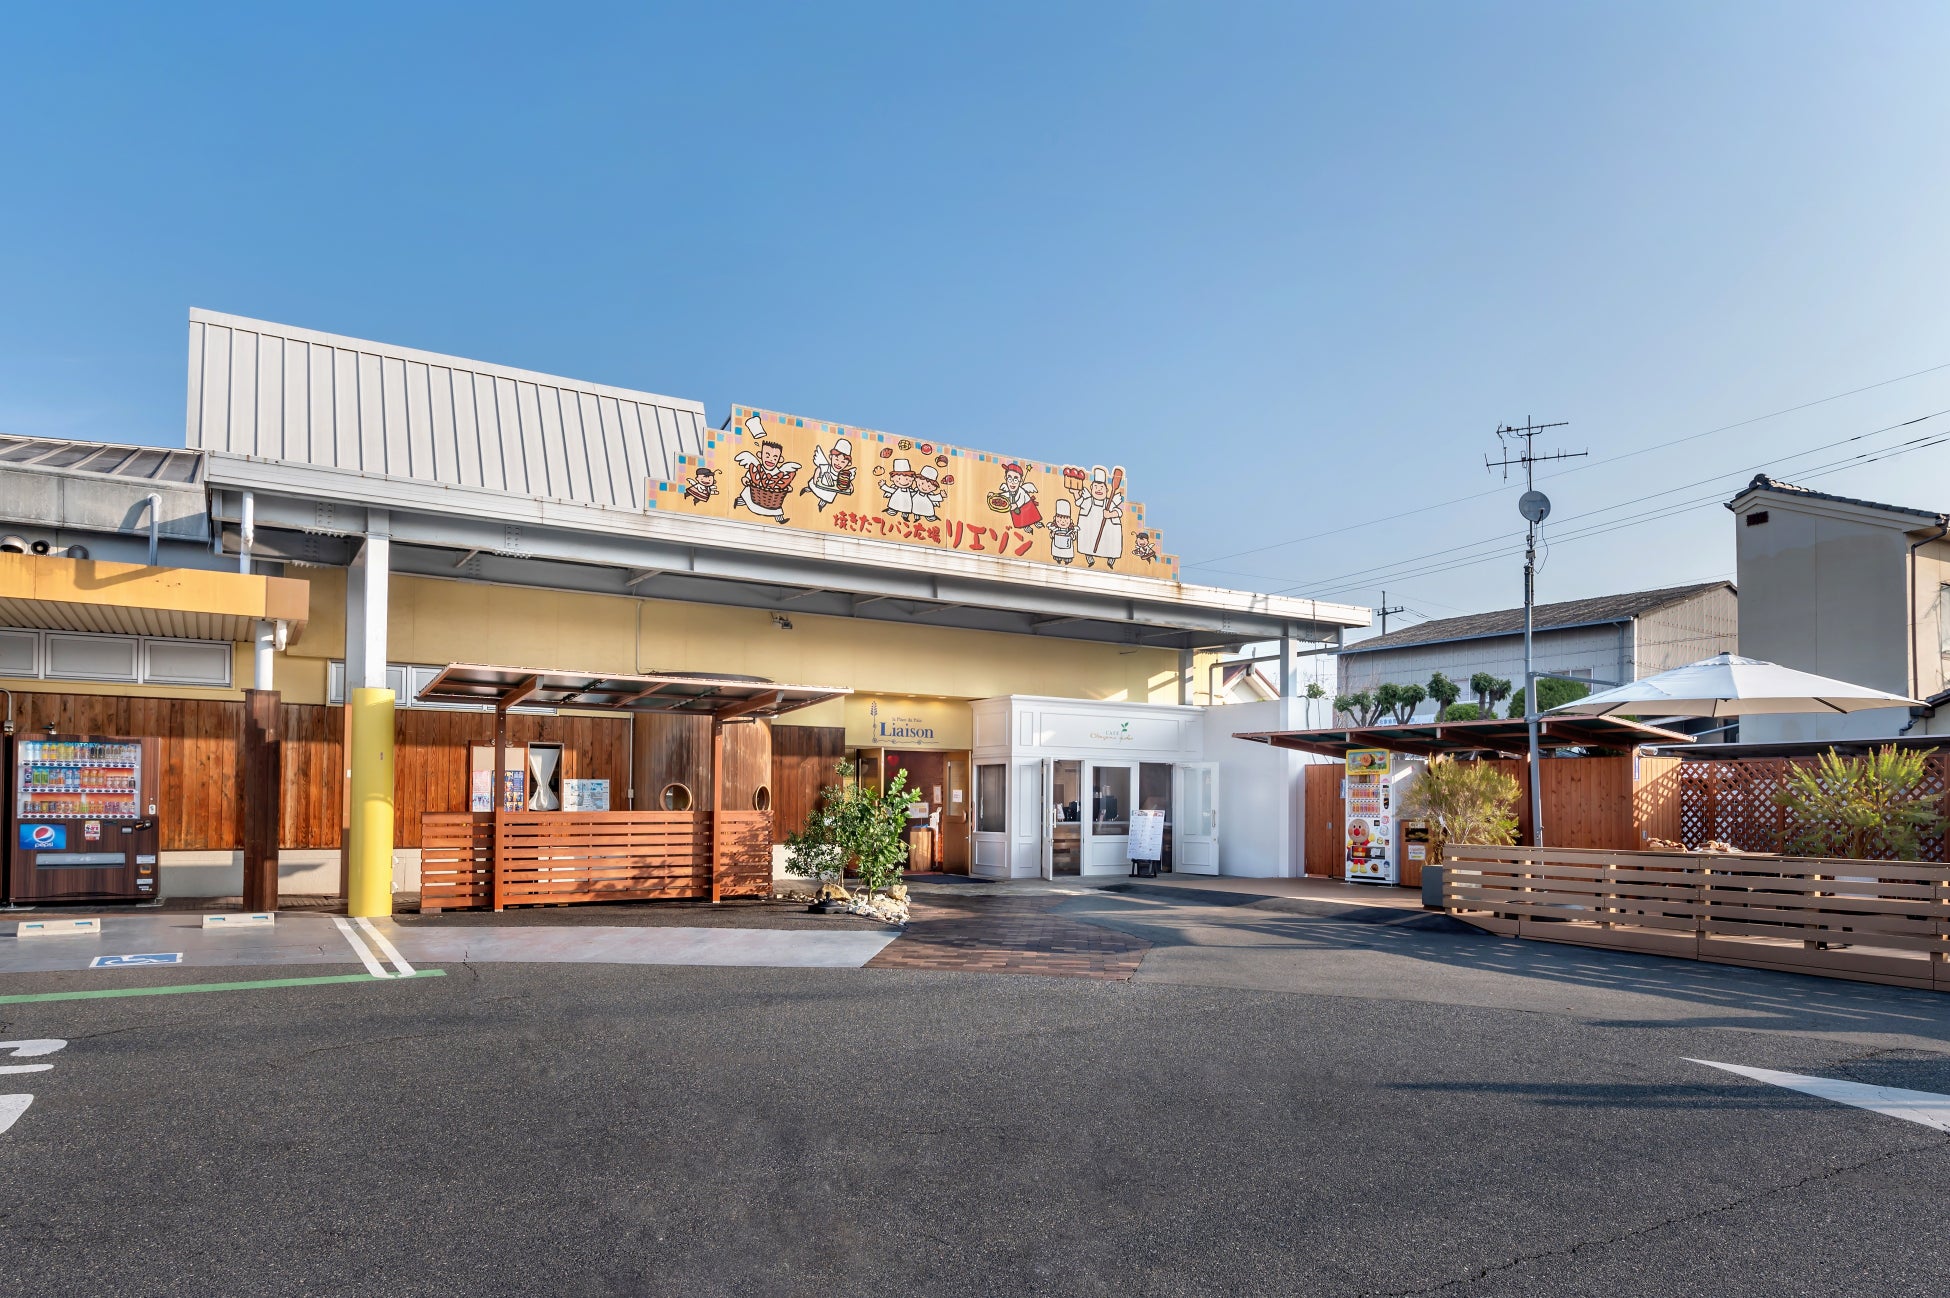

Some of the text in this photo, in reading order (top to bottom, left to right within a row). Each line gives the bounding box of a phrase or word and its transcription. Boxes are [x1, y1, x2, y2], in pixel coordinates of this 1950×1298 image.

[946, 519, 1034, 557] リエゾン
[880, 722, 934, 738] Liaison
